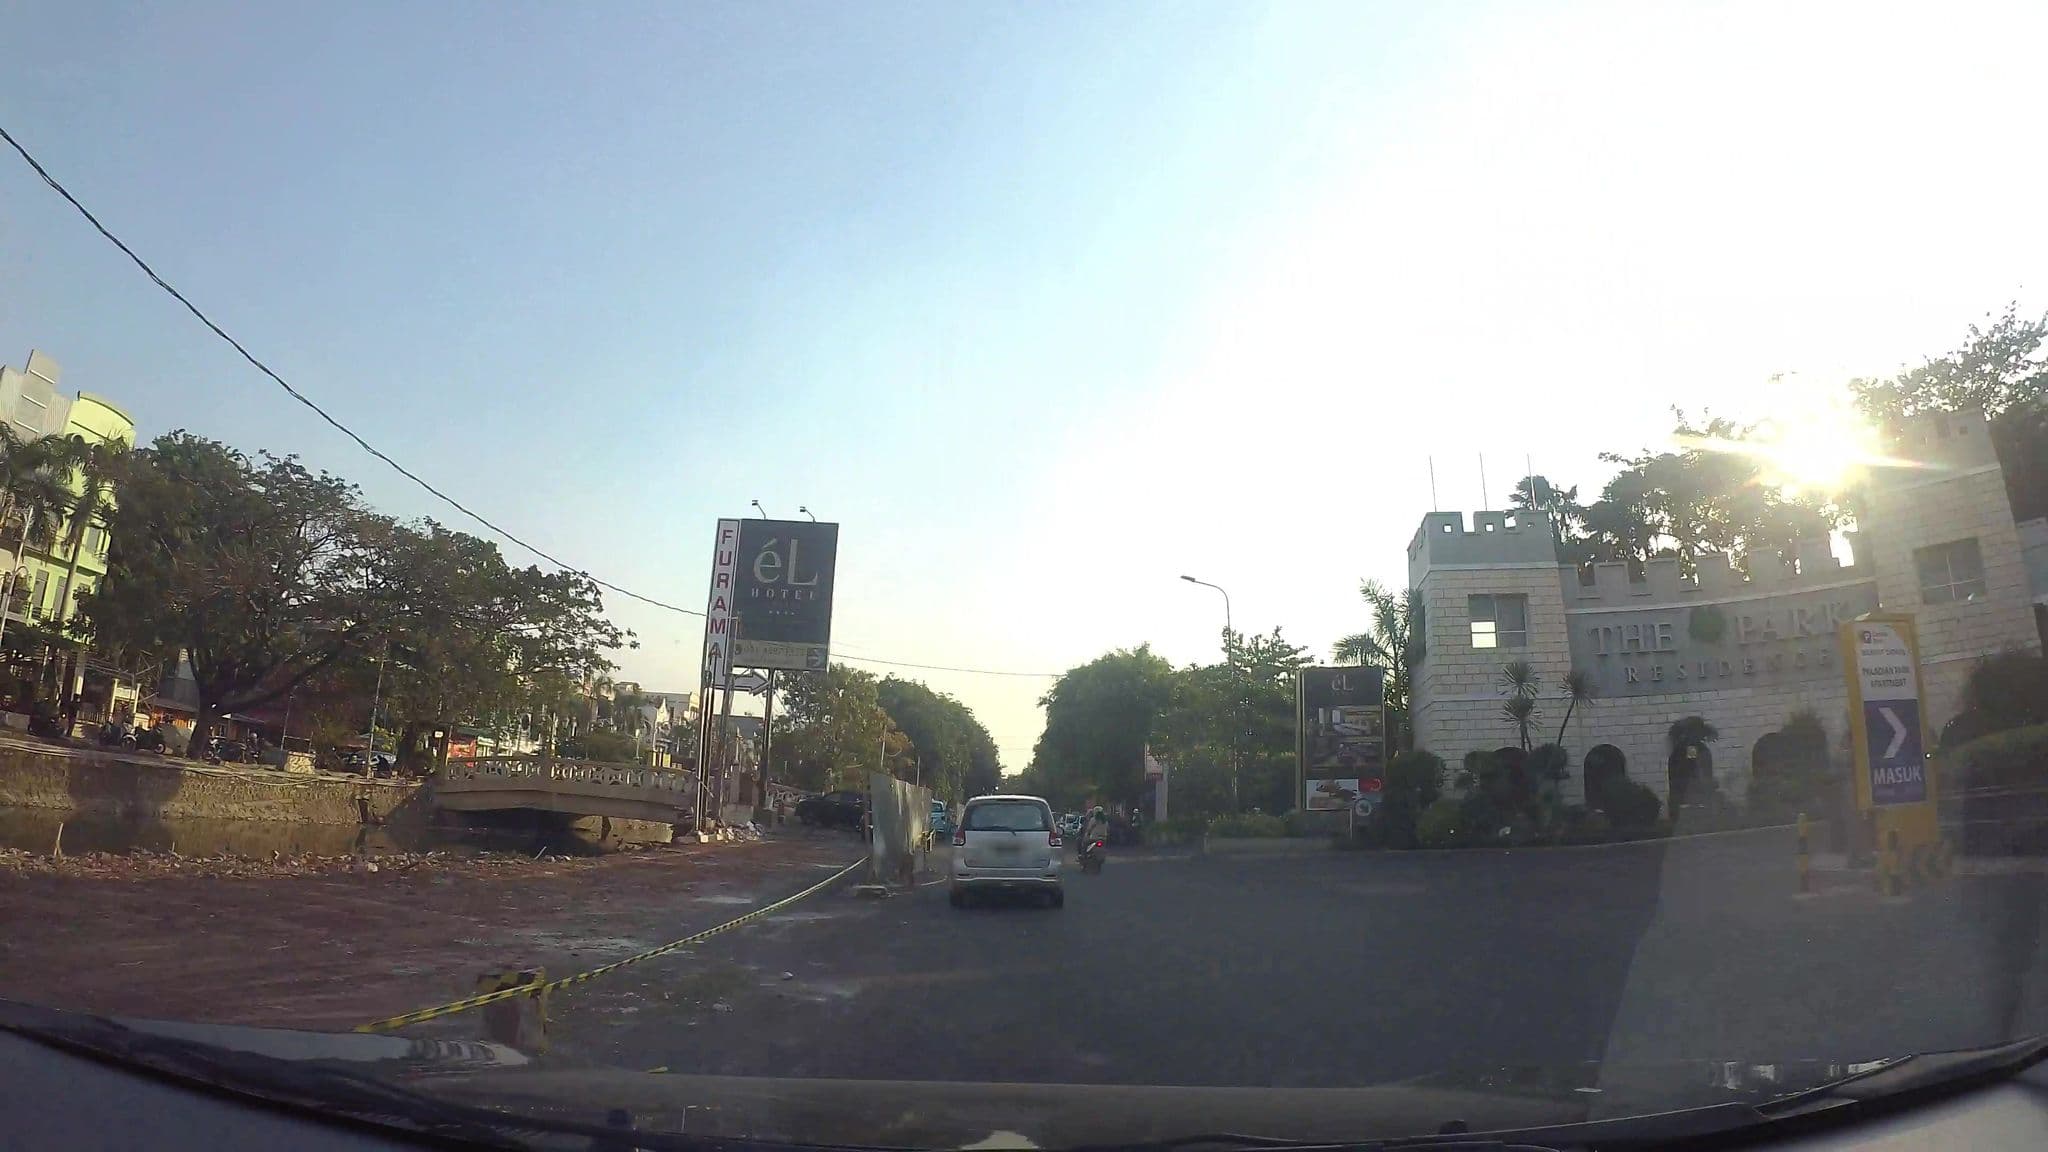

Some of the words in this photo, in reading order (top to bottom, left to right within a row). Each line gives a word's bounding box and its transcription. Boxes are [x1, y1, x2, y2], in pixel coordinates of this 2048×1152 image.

[708, 529, 733, 659] FURAMA
[752, 588, 816, 600] HOTEL
[1590, 623, 1676, 655] THE
[1736, 602, 1842, 644] PARK
[1625, 648, 1832, 683] RESIDENCE
[1874, 765, 1922, 784] MASUK
